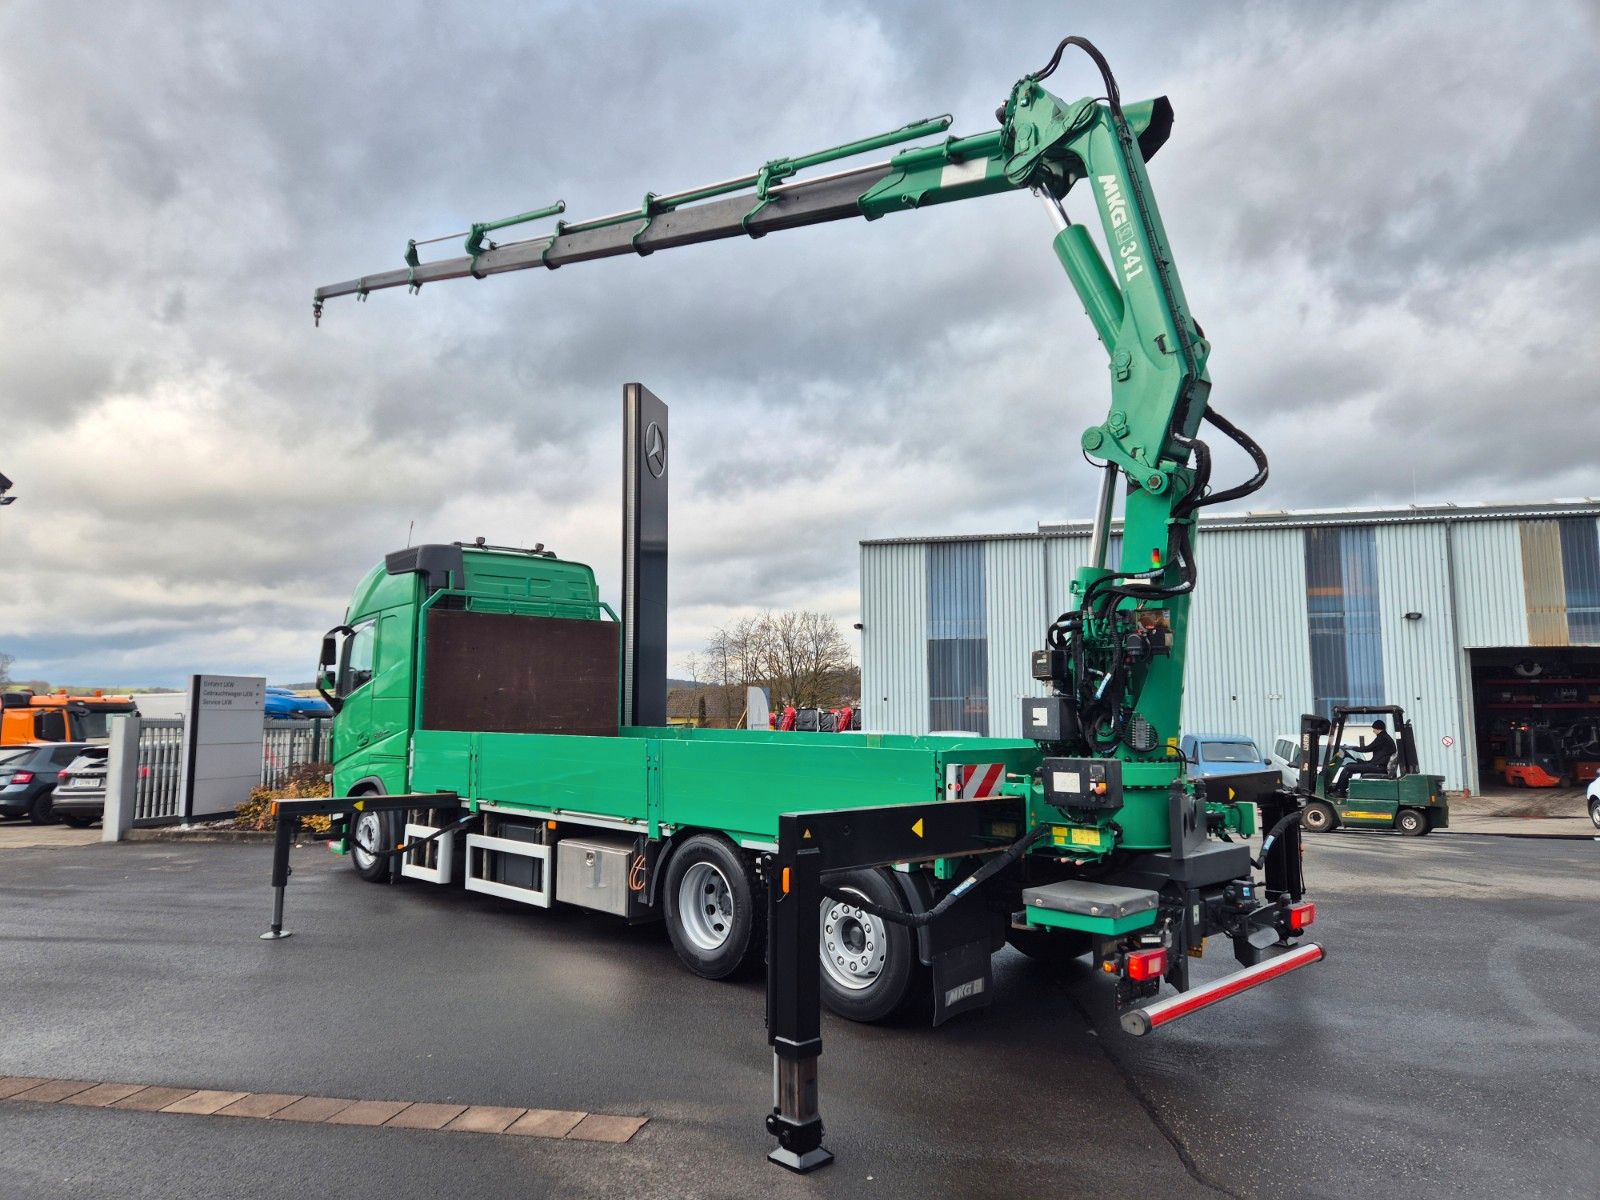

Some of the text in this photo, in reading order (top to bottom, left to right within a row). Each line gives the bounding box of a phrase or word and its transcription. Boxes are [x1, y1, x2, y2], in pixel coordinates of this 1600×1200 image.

[1098, 174, 1143, 282] MKG 341
[947, 984, 972, 1006] MKG
